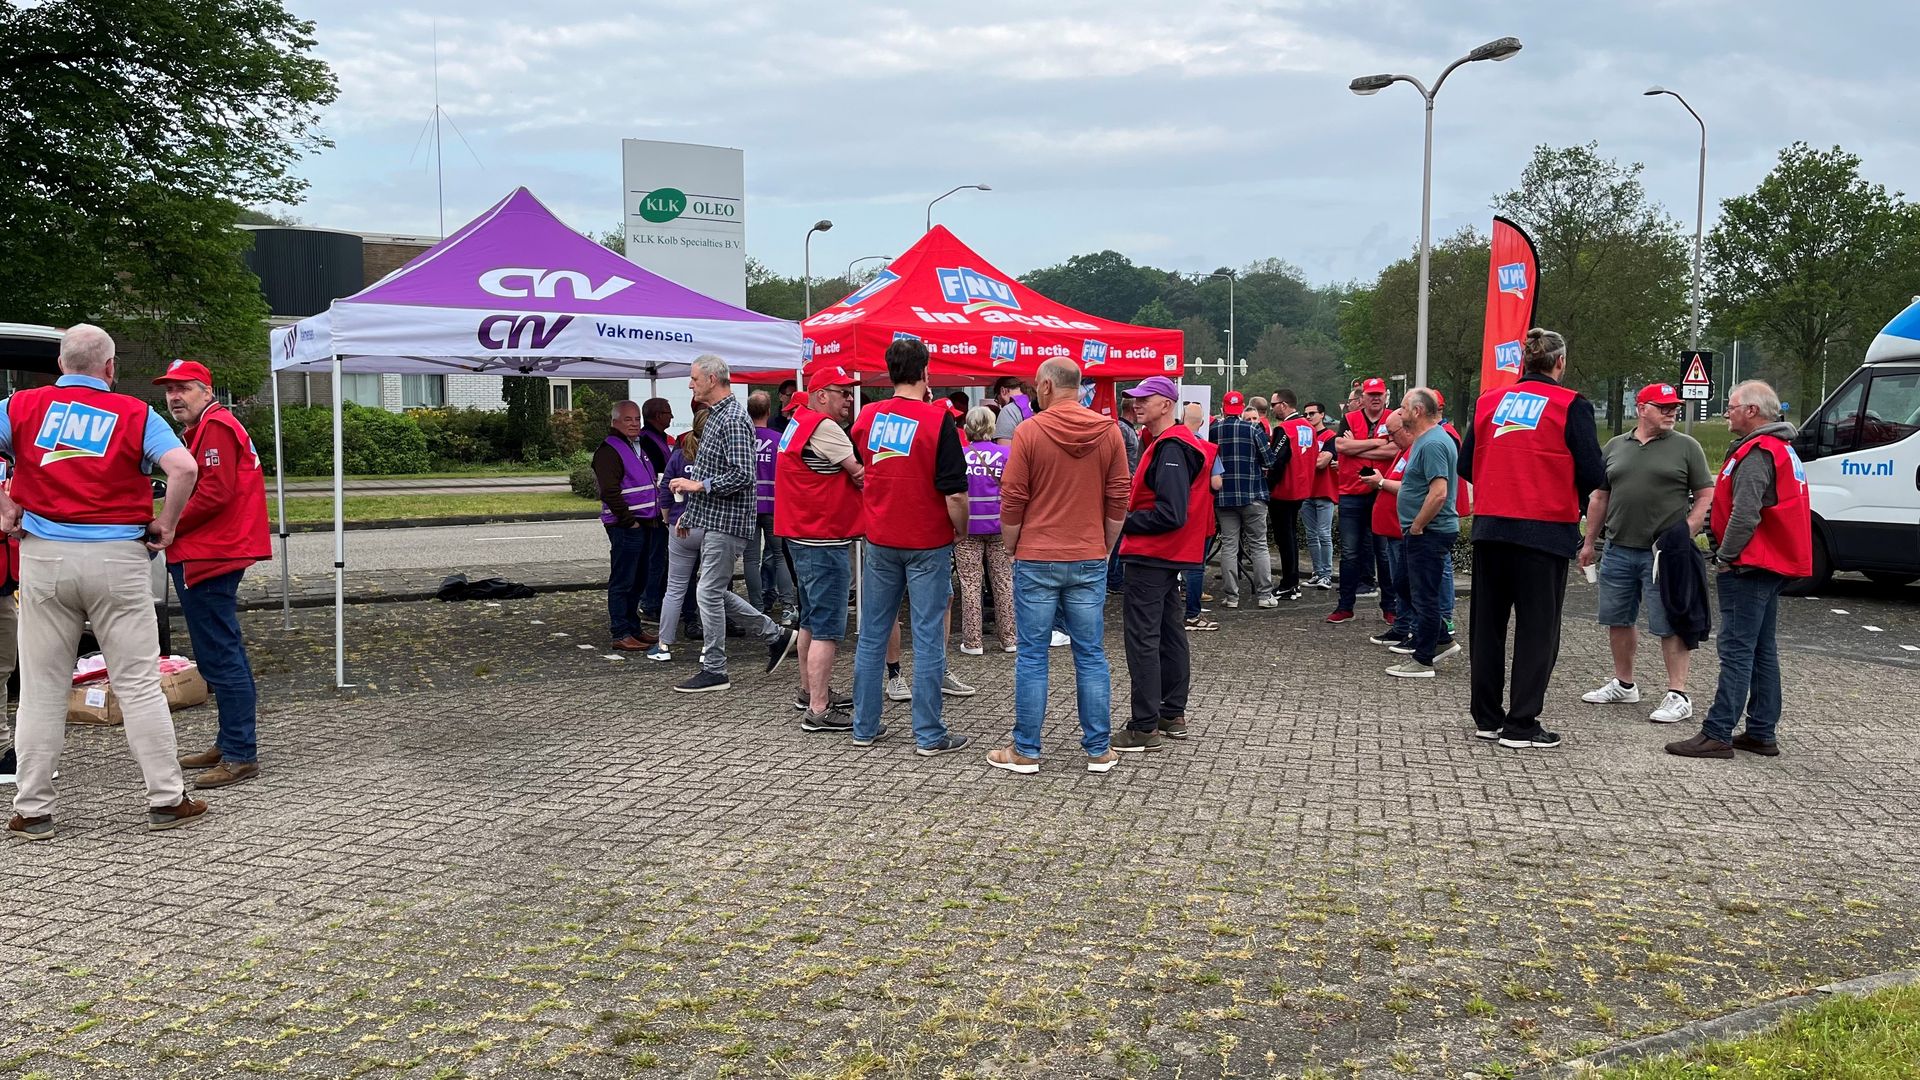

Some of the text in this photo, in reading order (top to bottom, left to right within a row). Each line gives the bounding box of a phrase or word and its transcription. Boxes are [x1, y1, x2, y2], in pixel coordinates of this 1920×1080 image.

[646, 198, 734, 217] KLK OLEO
[633, 234, 741, 249] KLK Kolb Specialties B.V.
[943, 276, 1010, 301] FNV
[910, 306, 1101, 331] in actie
[596, 322, 693, 343] Vakmensen
[814, 342, 821, 355] in
[822, 340, 841, 354] actie
[942, 341, 977, 355] actie
[992, 341, 1070, 356] FNV in actie
[1083, 344, 1157, 359] FNV in actie
[1688, 388, 1697, 396] 75
[1496, 398, 1545, 419] FNV
[42, 411, 115, 443] FNV
[870, 421, 916, 445] FNV
[1841, 458, 1894, 476] fnv.nl
